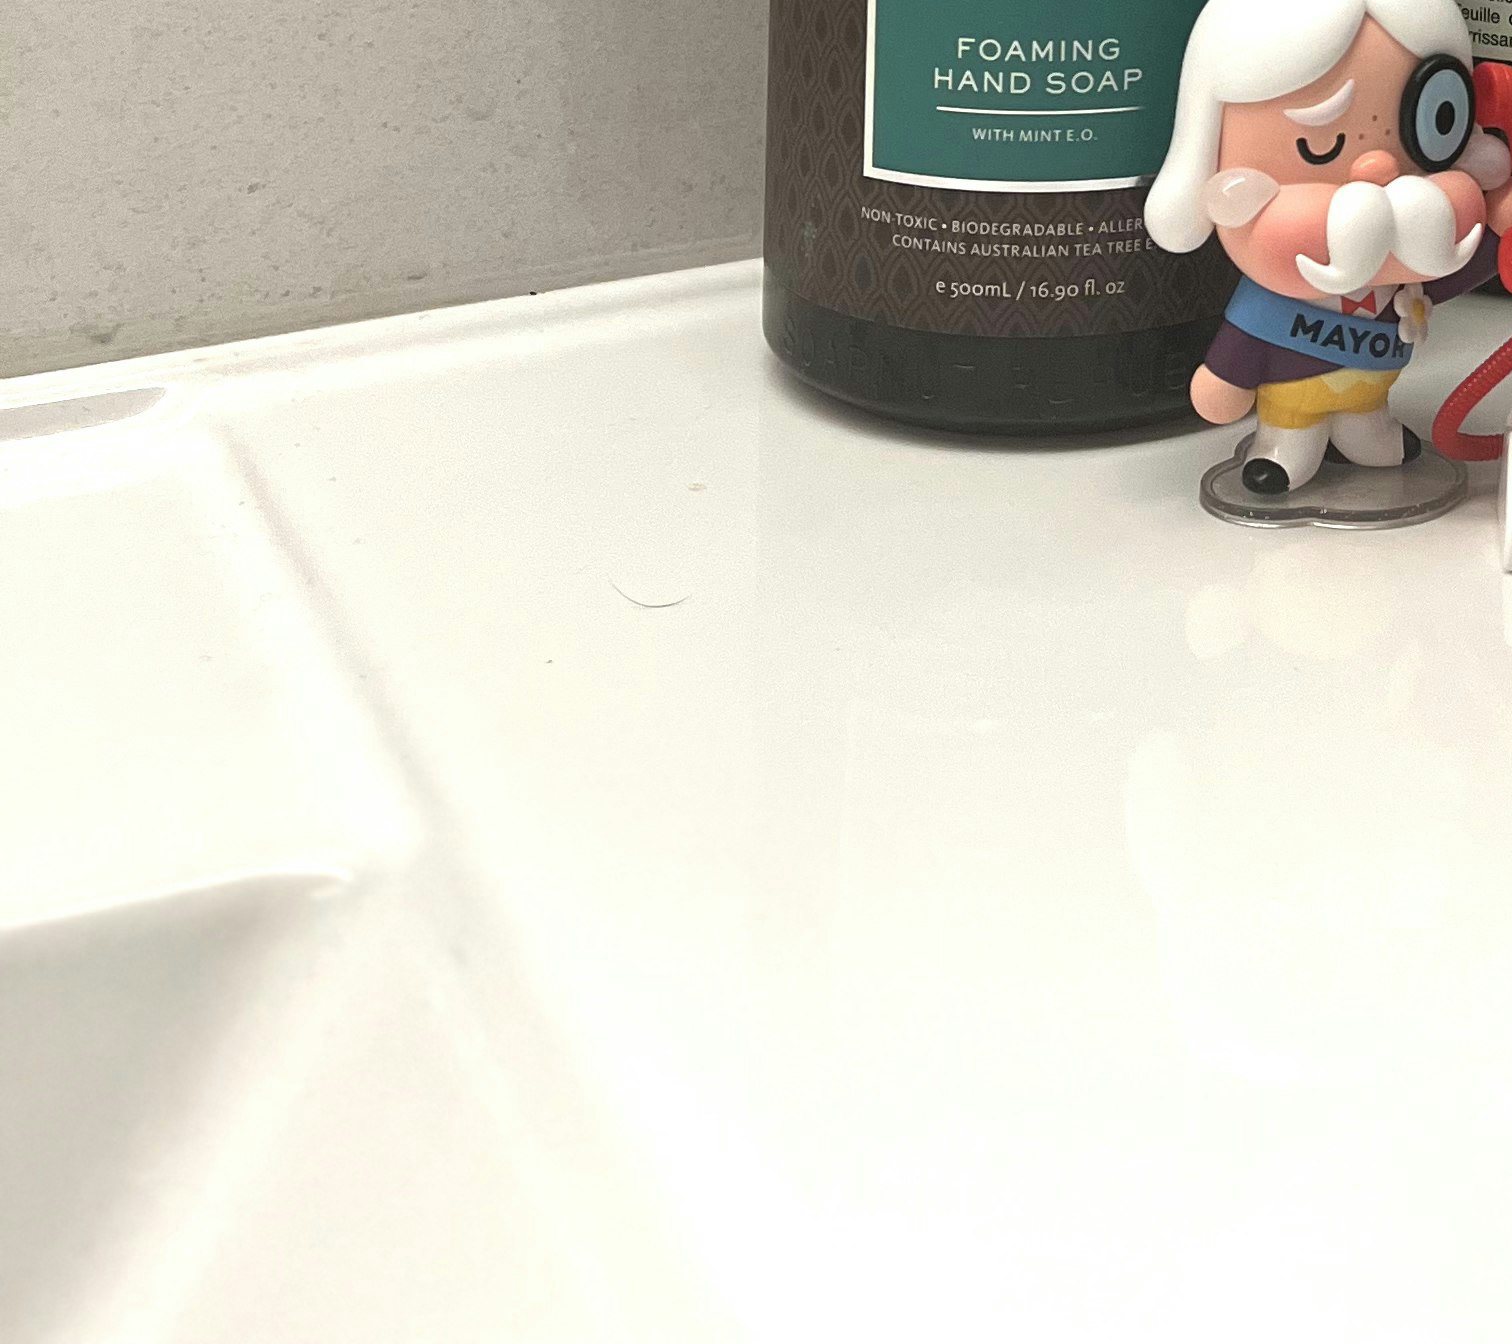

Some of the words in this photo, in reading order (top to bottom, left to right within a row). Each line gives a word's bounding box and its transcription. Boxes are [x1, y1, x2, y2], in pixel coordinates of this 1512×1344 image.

[1457, 2, 1500, 23] euille
[957, 37, 1120, 62] FOAMING
[933, 67, 1031, 94] HAND
[1045, 68, 1143, 94] SOAP
[971, 127, 1014, 142] WITH
[1018, 129, 1062, 142] MINT
[1066, 128, 1098, 142] E.O.
[860, 206, 938, 231] NON-TOXIC
[951, 220, 1084, 236] BIODEGRADABLE
[892, 234, 966, 255] CONTAINS
[970, 242, 1069, 258] AUSTRALIAN
[1074, 242, 1103, 256] TEA
[1107, 238, 1141, 254] TREE
[1145, 237, 1156, 250] E
[950, 281, 1012, 298] 500mL
[1030, 281, 1079, 301] 16.90
[1105, 280, 1126, 294] oz
